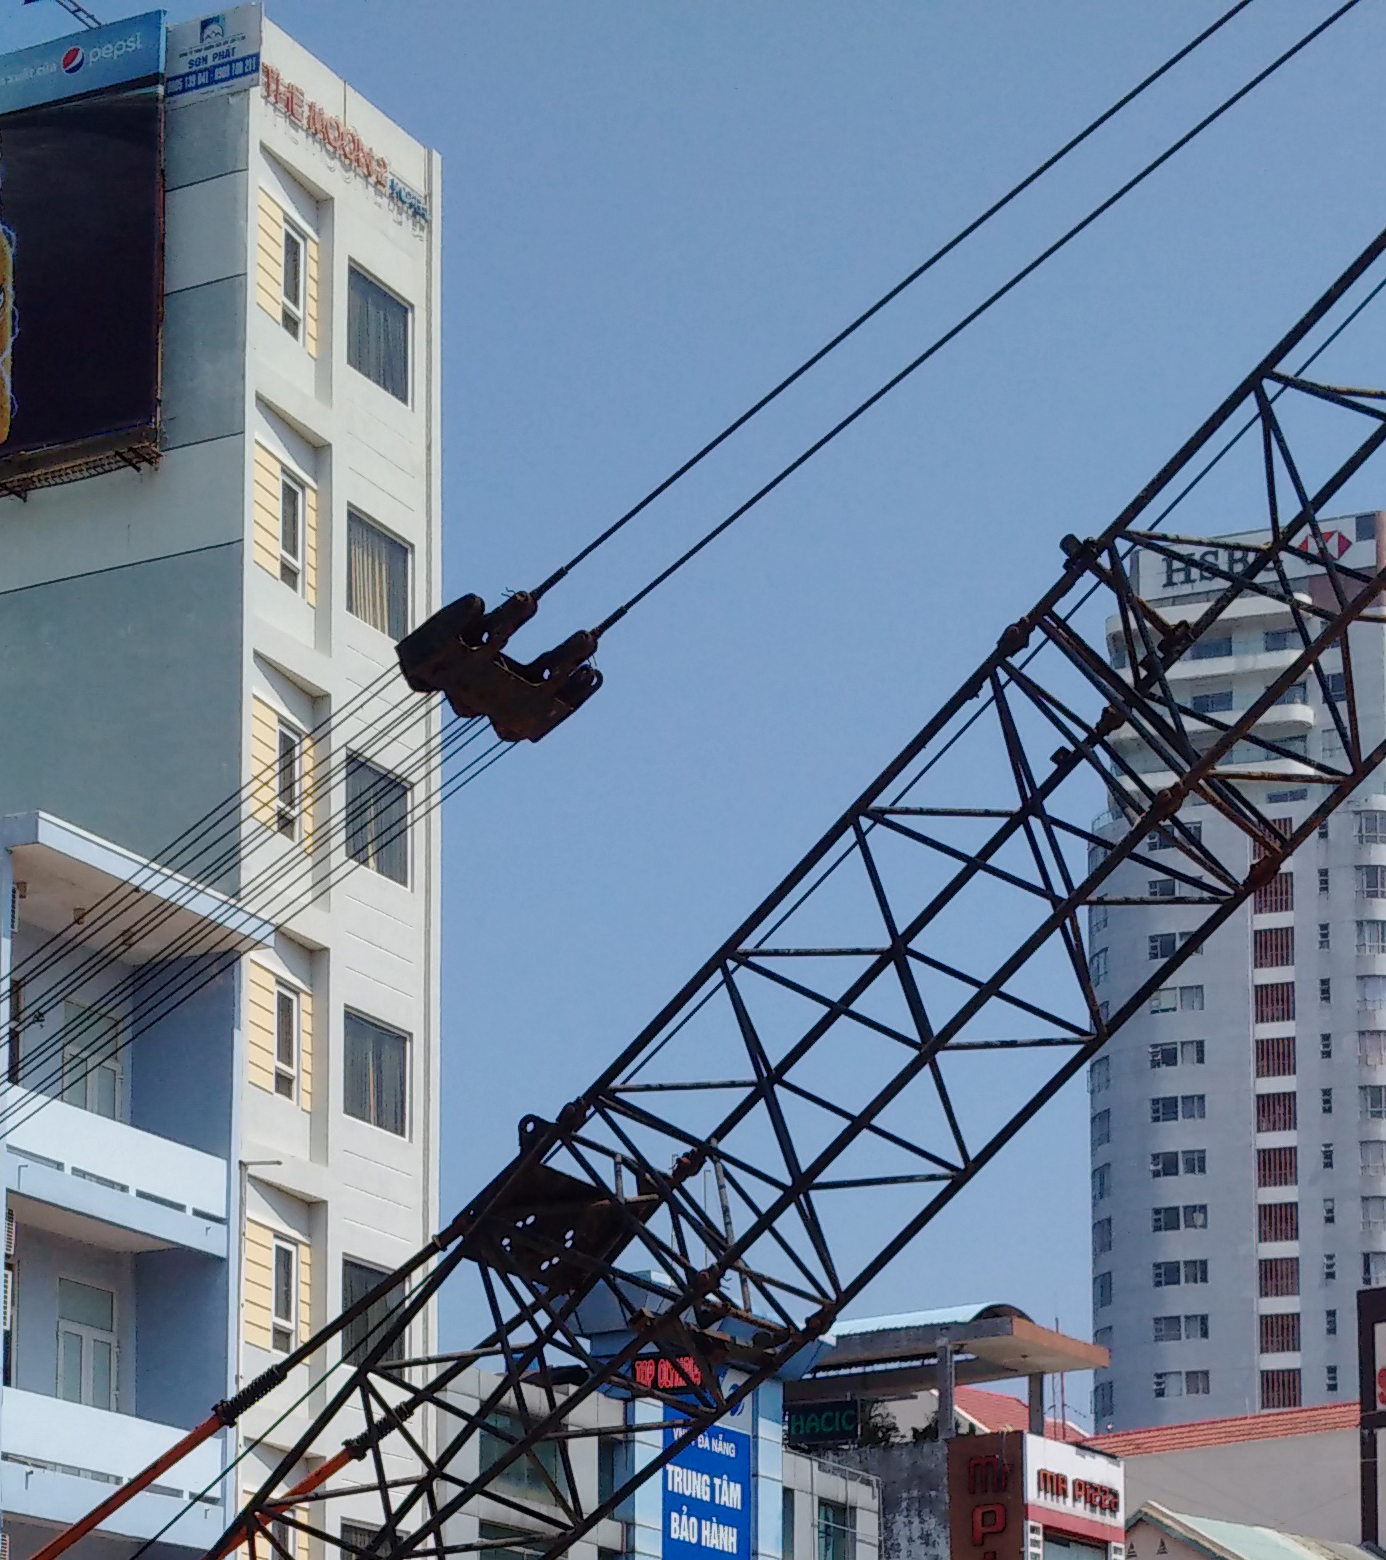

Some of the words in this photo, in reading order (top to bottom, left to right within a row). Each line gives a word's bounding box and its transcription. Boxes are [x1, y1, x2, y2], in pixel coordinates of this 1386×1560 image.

[88, 33, 142, 67] pepsi
[262, 61, 305, 123] THE
[791, 1410, 856, 1436] HACIC
[665, 1463, 711, 1503] TRUNG
[713, 1474, 742, 1510] TÂM
[670, 1505, 698, 1545] BẢO
[701, 1517, 738, 1555] HÀNH
